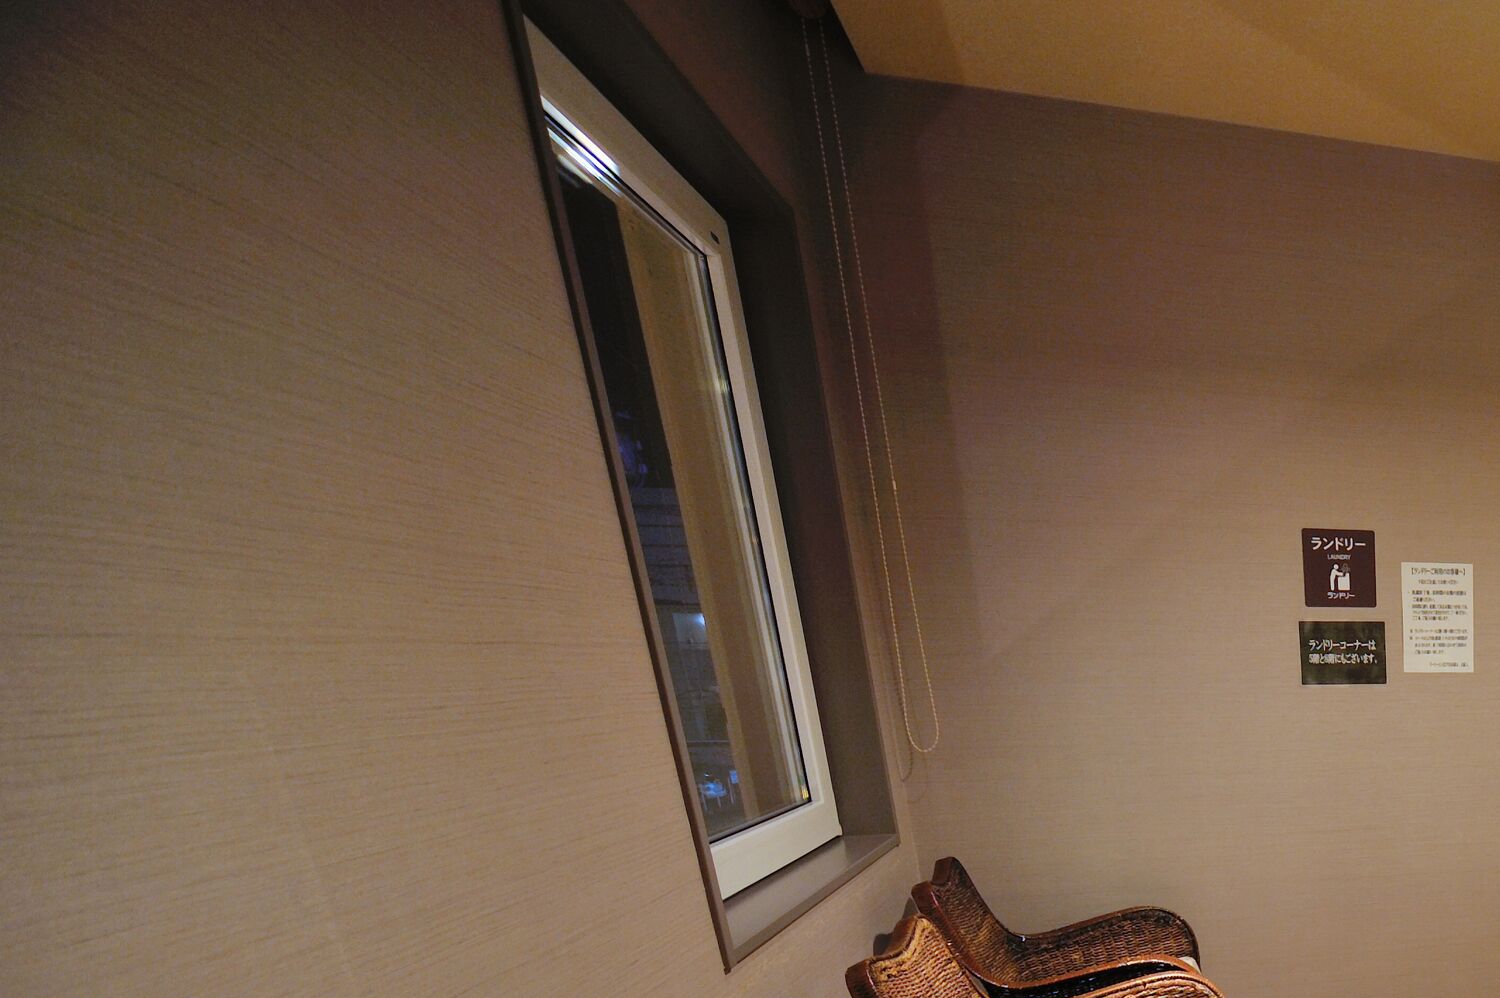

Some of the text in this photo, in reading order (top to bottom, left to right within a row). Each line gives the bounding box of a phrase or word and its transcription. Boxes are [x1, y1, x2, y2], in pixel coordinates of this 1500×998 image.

[1311, 537, 1366, 551] ランドリー
[1308, 639, 1377, 651] ランドリーコーナーは
